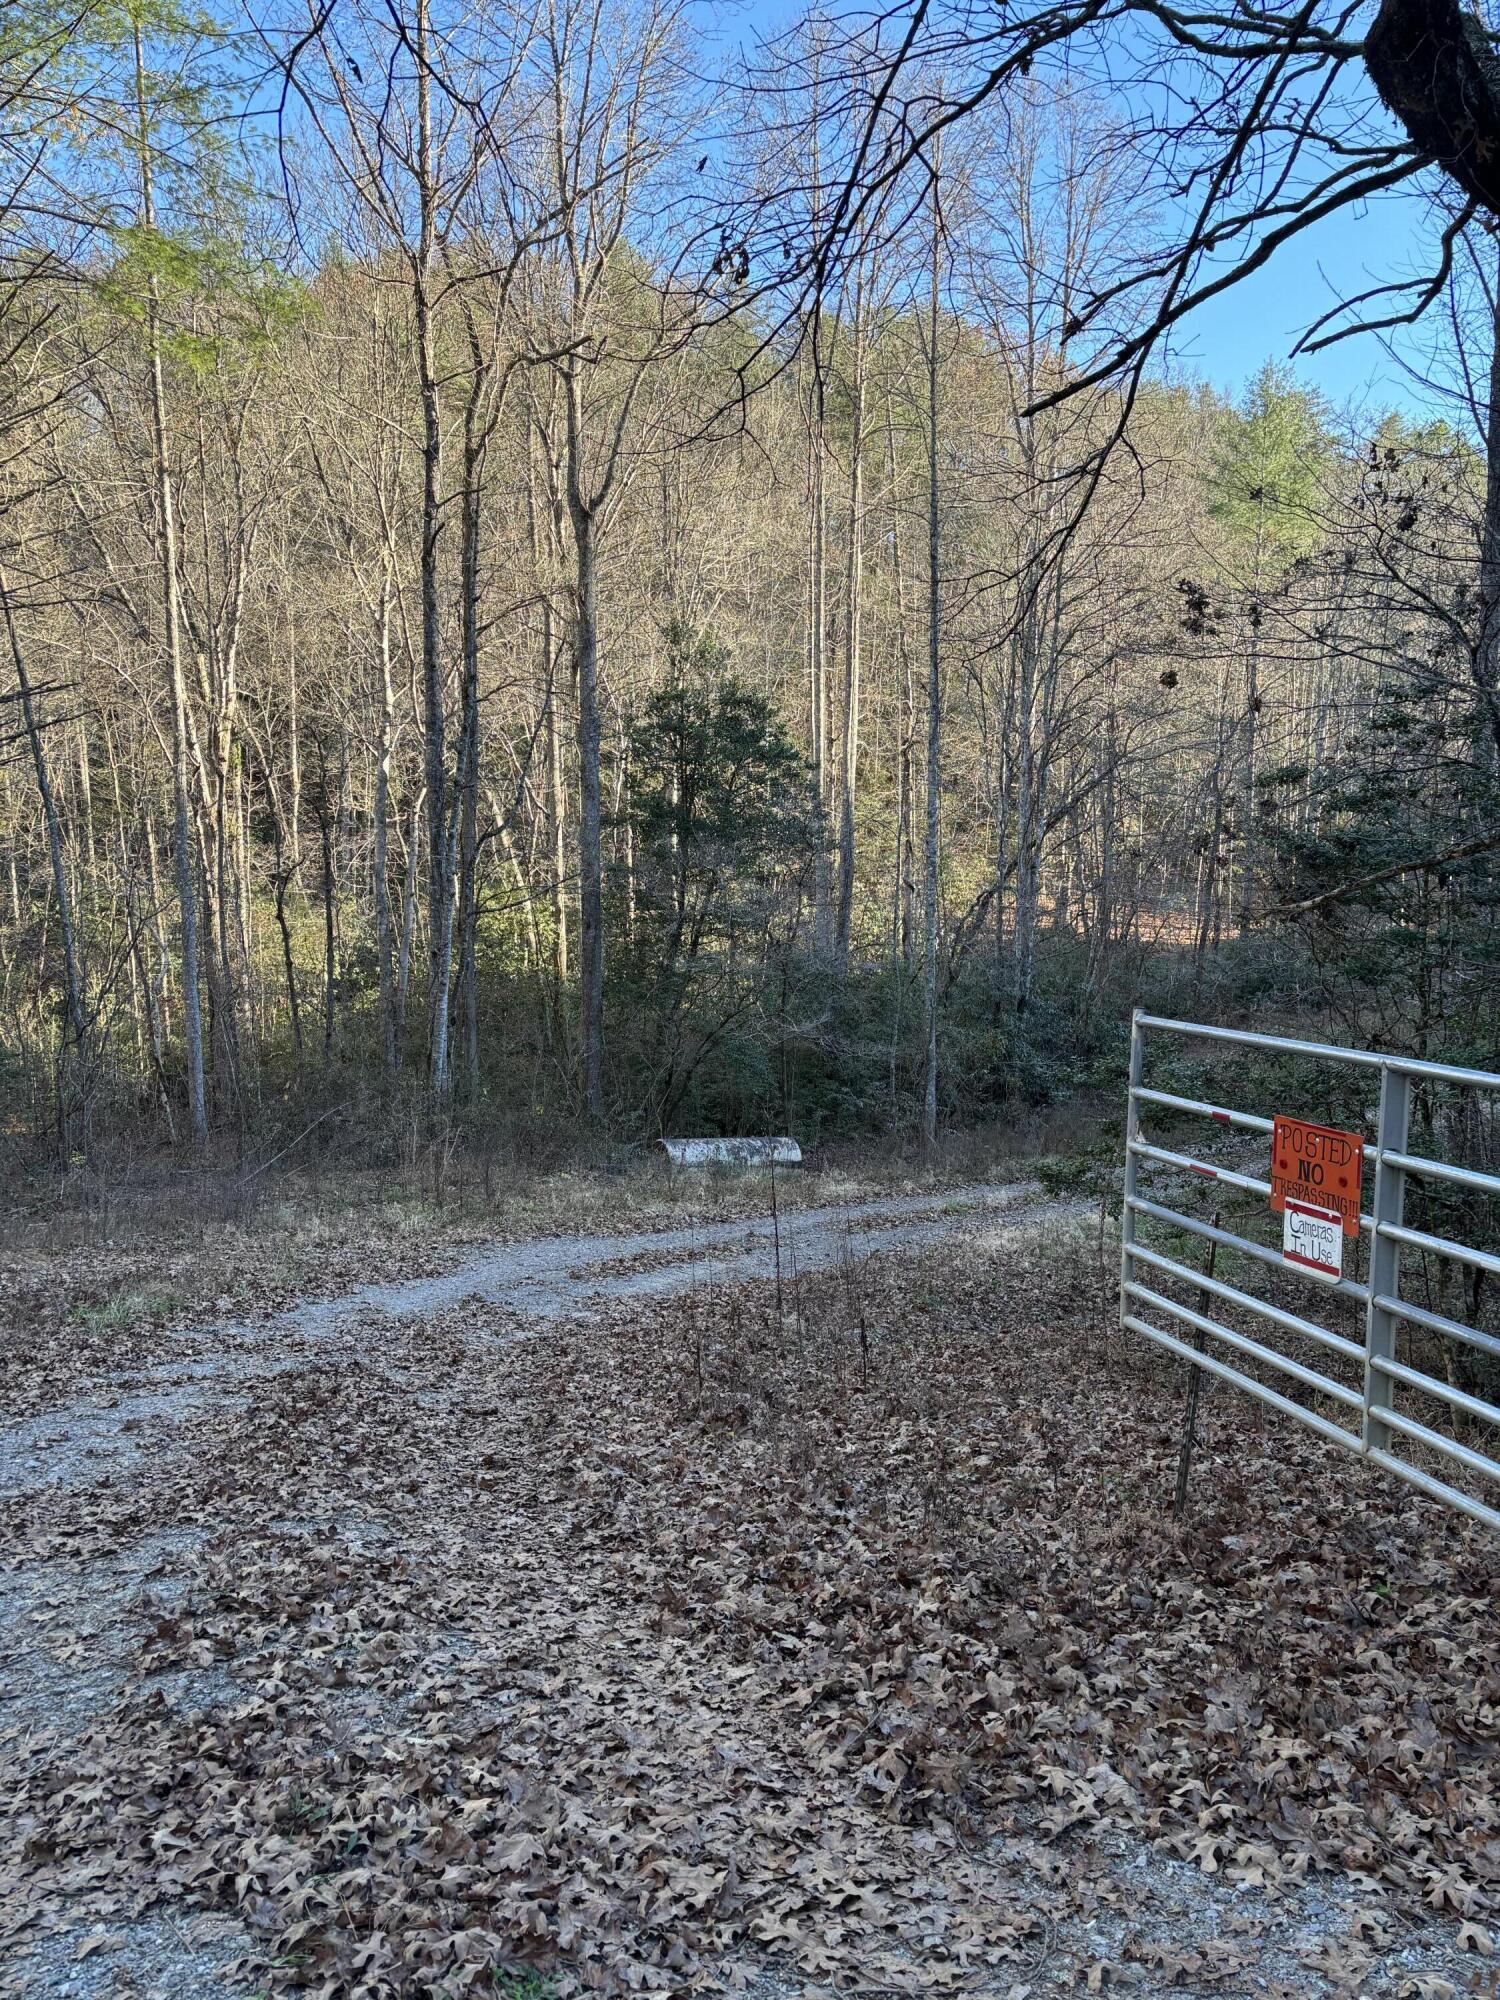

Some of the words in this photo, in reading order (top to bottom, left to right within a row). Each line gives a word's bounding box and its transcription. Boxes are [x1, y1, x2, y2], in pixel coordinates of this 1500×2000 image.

[1281, 1124, 1352, 1166] POSTED
[1298, 1158, 1324, 1185] NO
[1290, 1211, 1334, 1243] Cameras
[1291, 1234, 1307, 1258] In
[1312, 1240, 1334, 1265] Use
